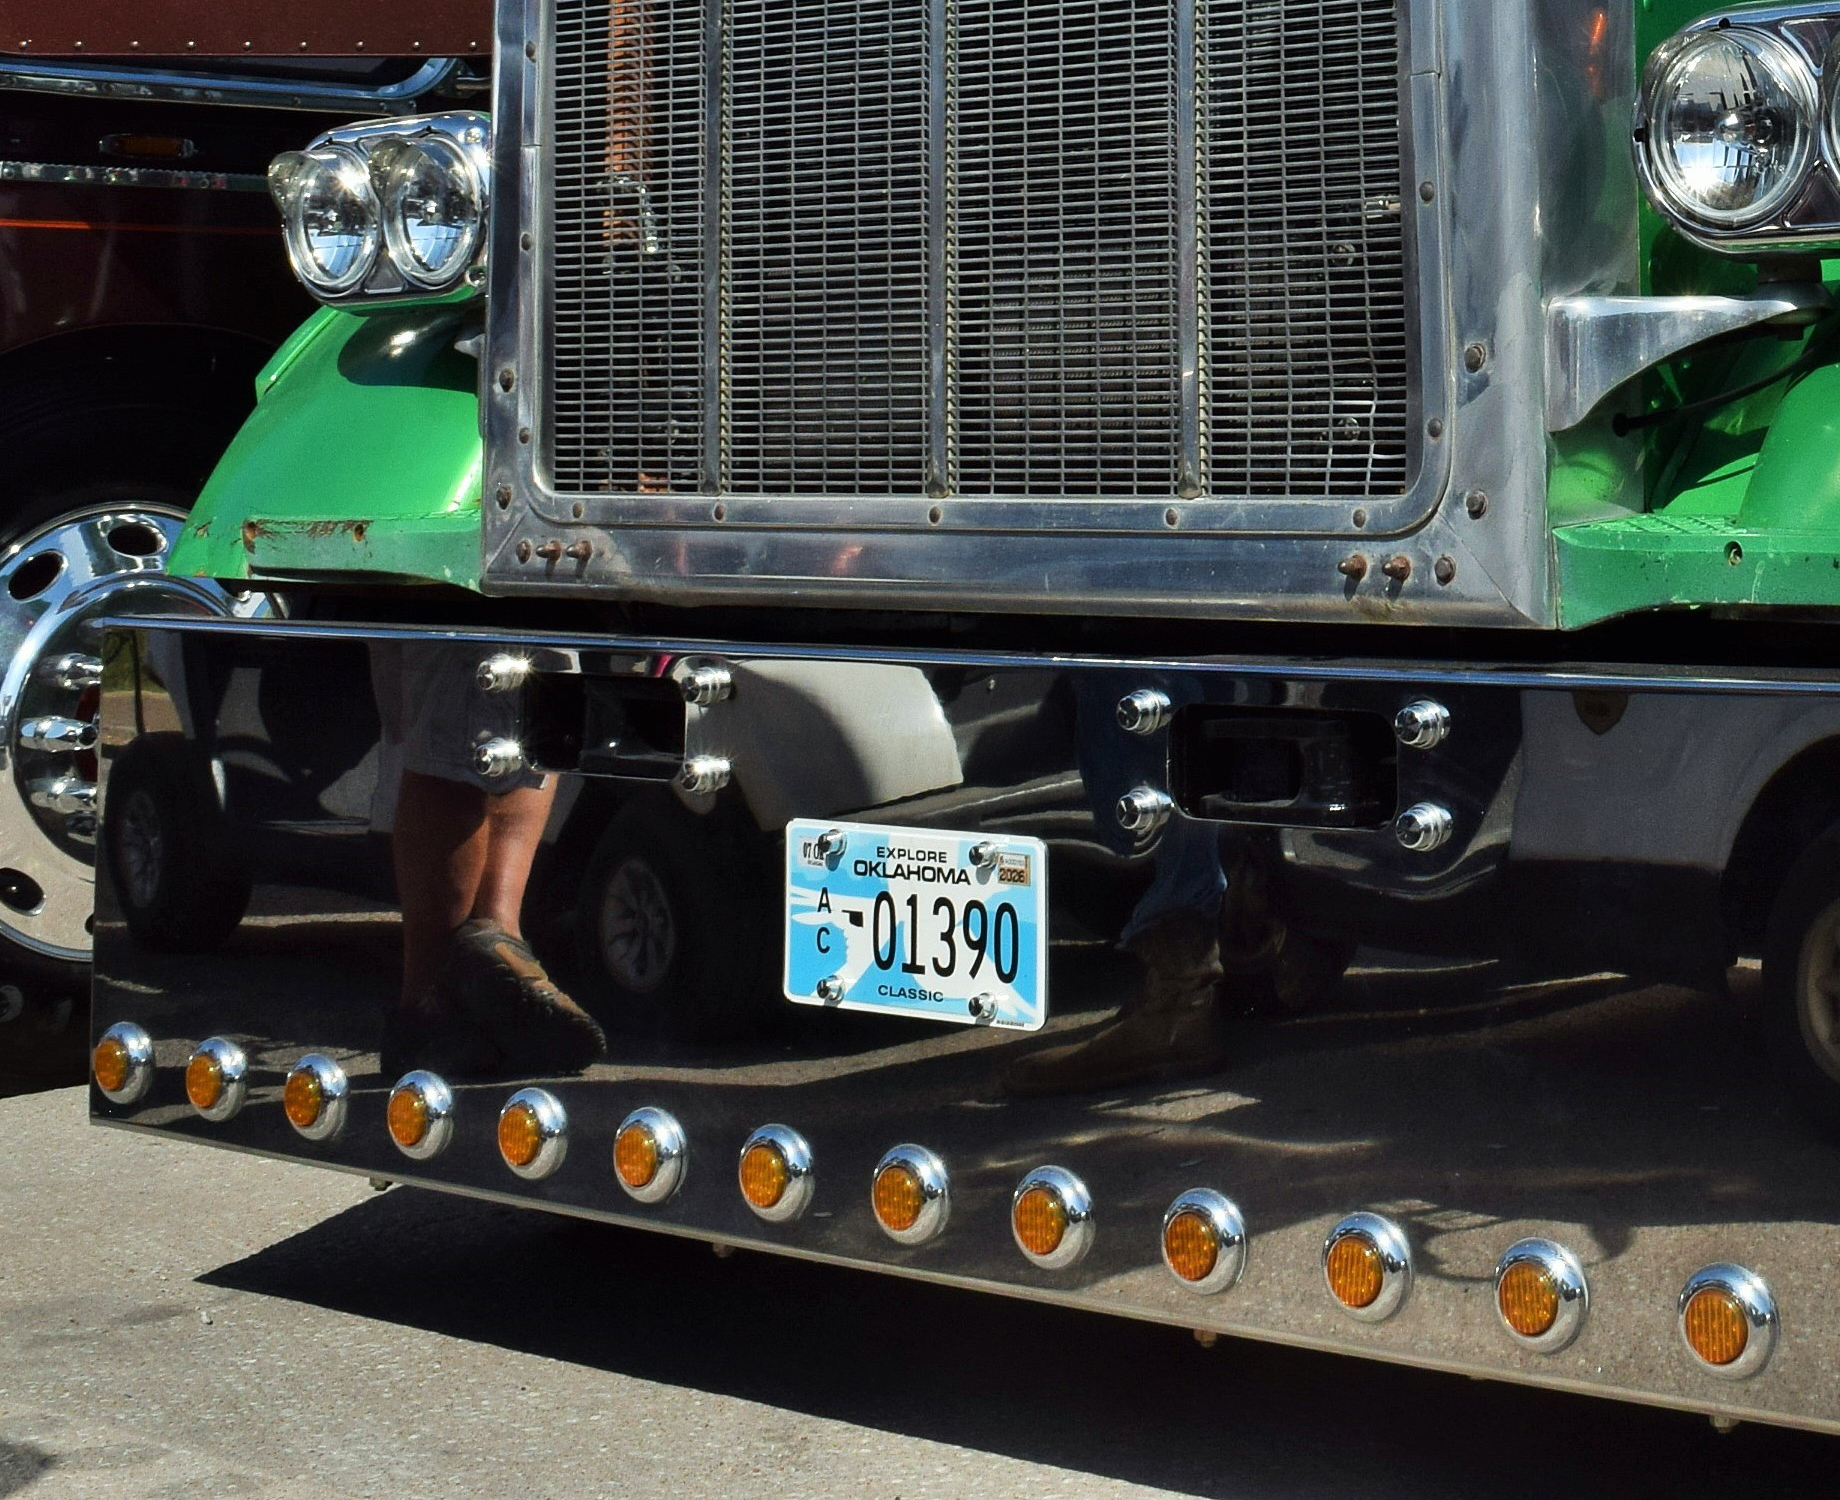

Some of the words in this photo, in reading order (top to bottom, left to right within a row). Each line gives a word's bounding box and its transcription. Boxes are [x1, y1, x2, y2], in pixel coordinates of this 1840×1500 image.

[876, 846, 948, 863] EXPLORE
[853, 859, 971, 885] OKLAHOMA
[872, 890, 1019, 984] 01390
[877, 984, 944, 1002] CLASSIC
